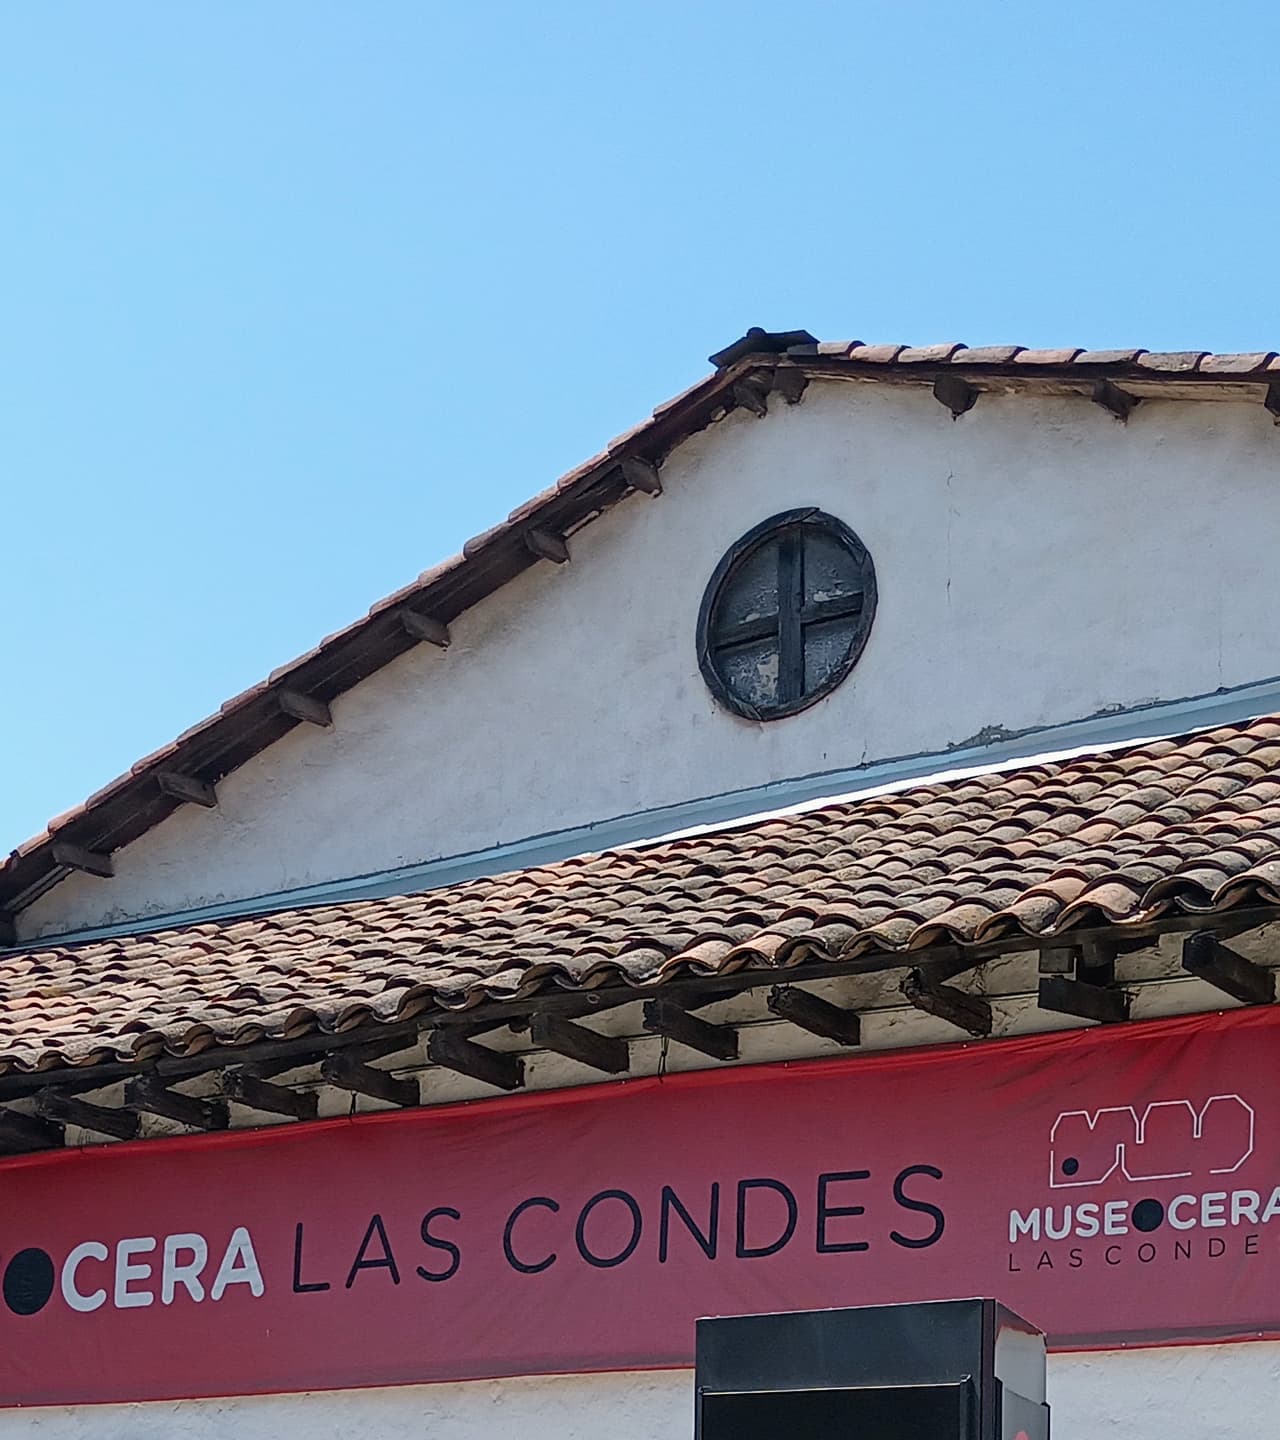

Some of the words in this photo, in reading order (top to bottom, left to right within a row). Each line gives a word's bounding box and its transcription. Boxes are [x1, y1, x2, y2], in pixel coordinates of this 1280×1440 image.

[293, 1208, 462, 1293] LAS
[503, 1164, 945, 1274] CONDES
[1008, 1248, 1083, 1272] LAS
